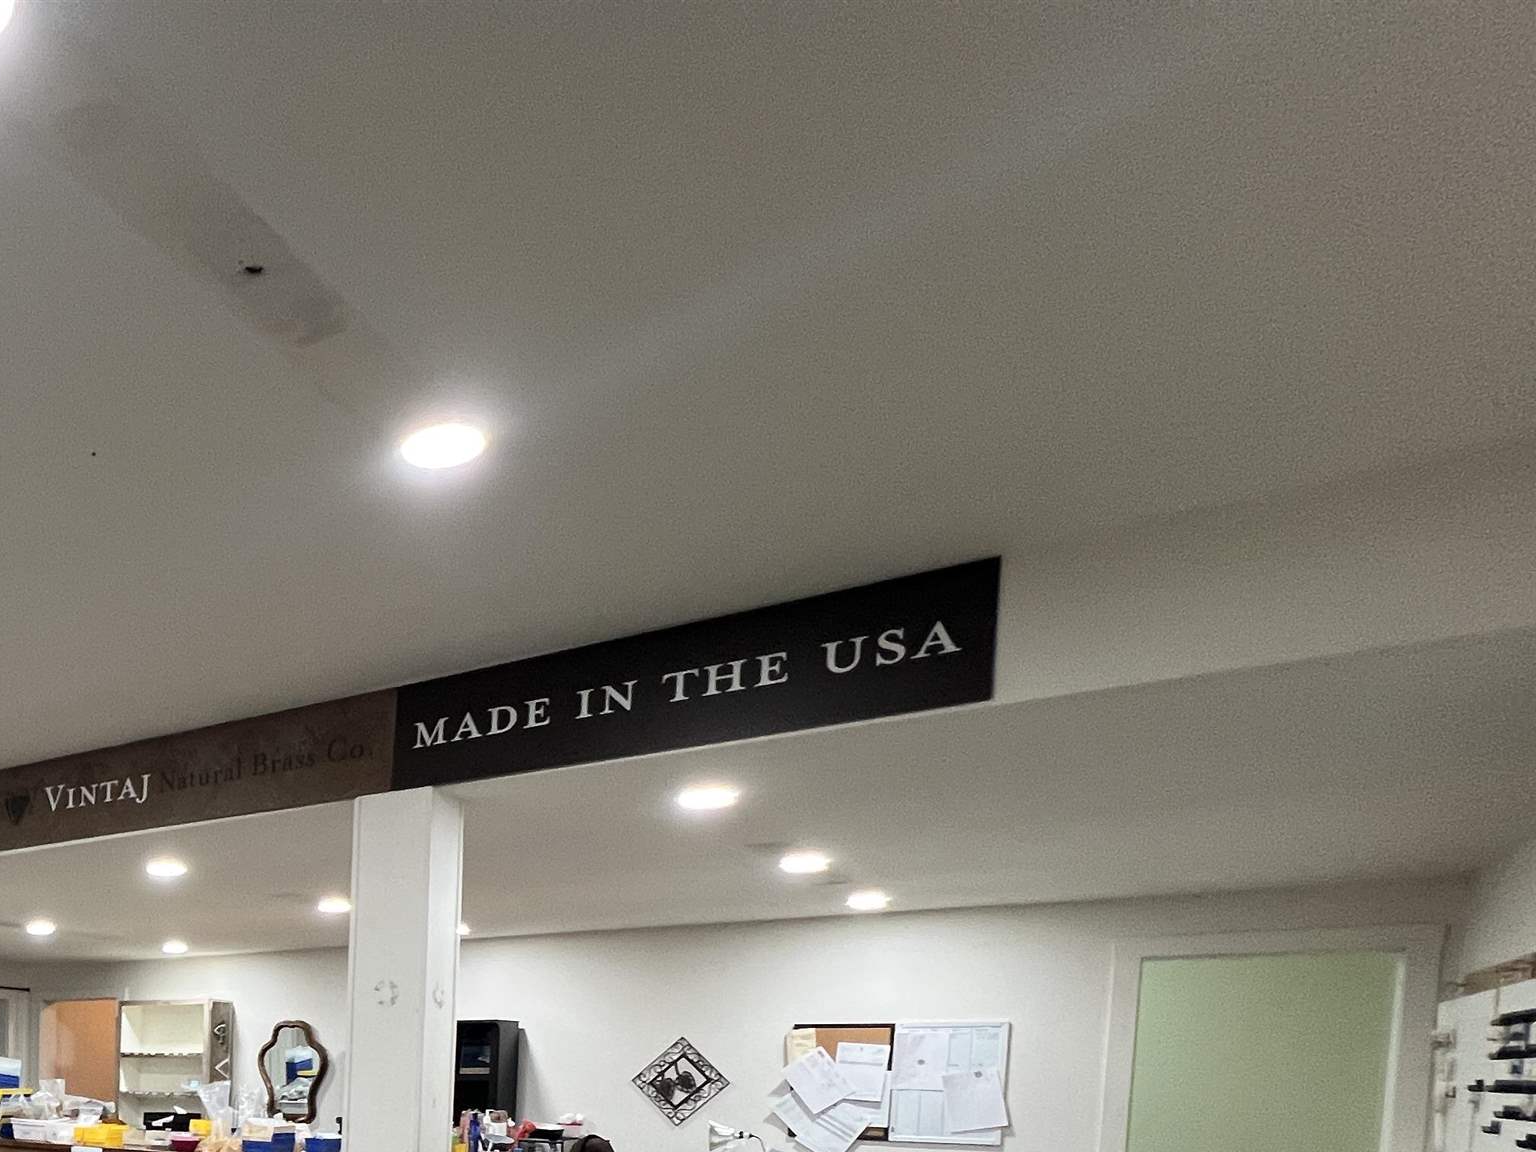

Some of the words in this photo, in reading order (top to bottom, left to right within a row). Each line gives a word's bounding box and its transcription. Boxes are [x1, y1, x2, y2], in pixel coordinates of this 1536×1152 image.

[412, 697, 551, 751] MADE
[575, 681, 639, 721] IN
[662, 651, 790, 703] THE
[821, 619, 964, 676] USA
[45, 773, 152, 812] VINTAJ
[161, 756, 242, 793] Natural
[252, 748, 316, 778] Brass
[327, 737, 375, 763] Co.
